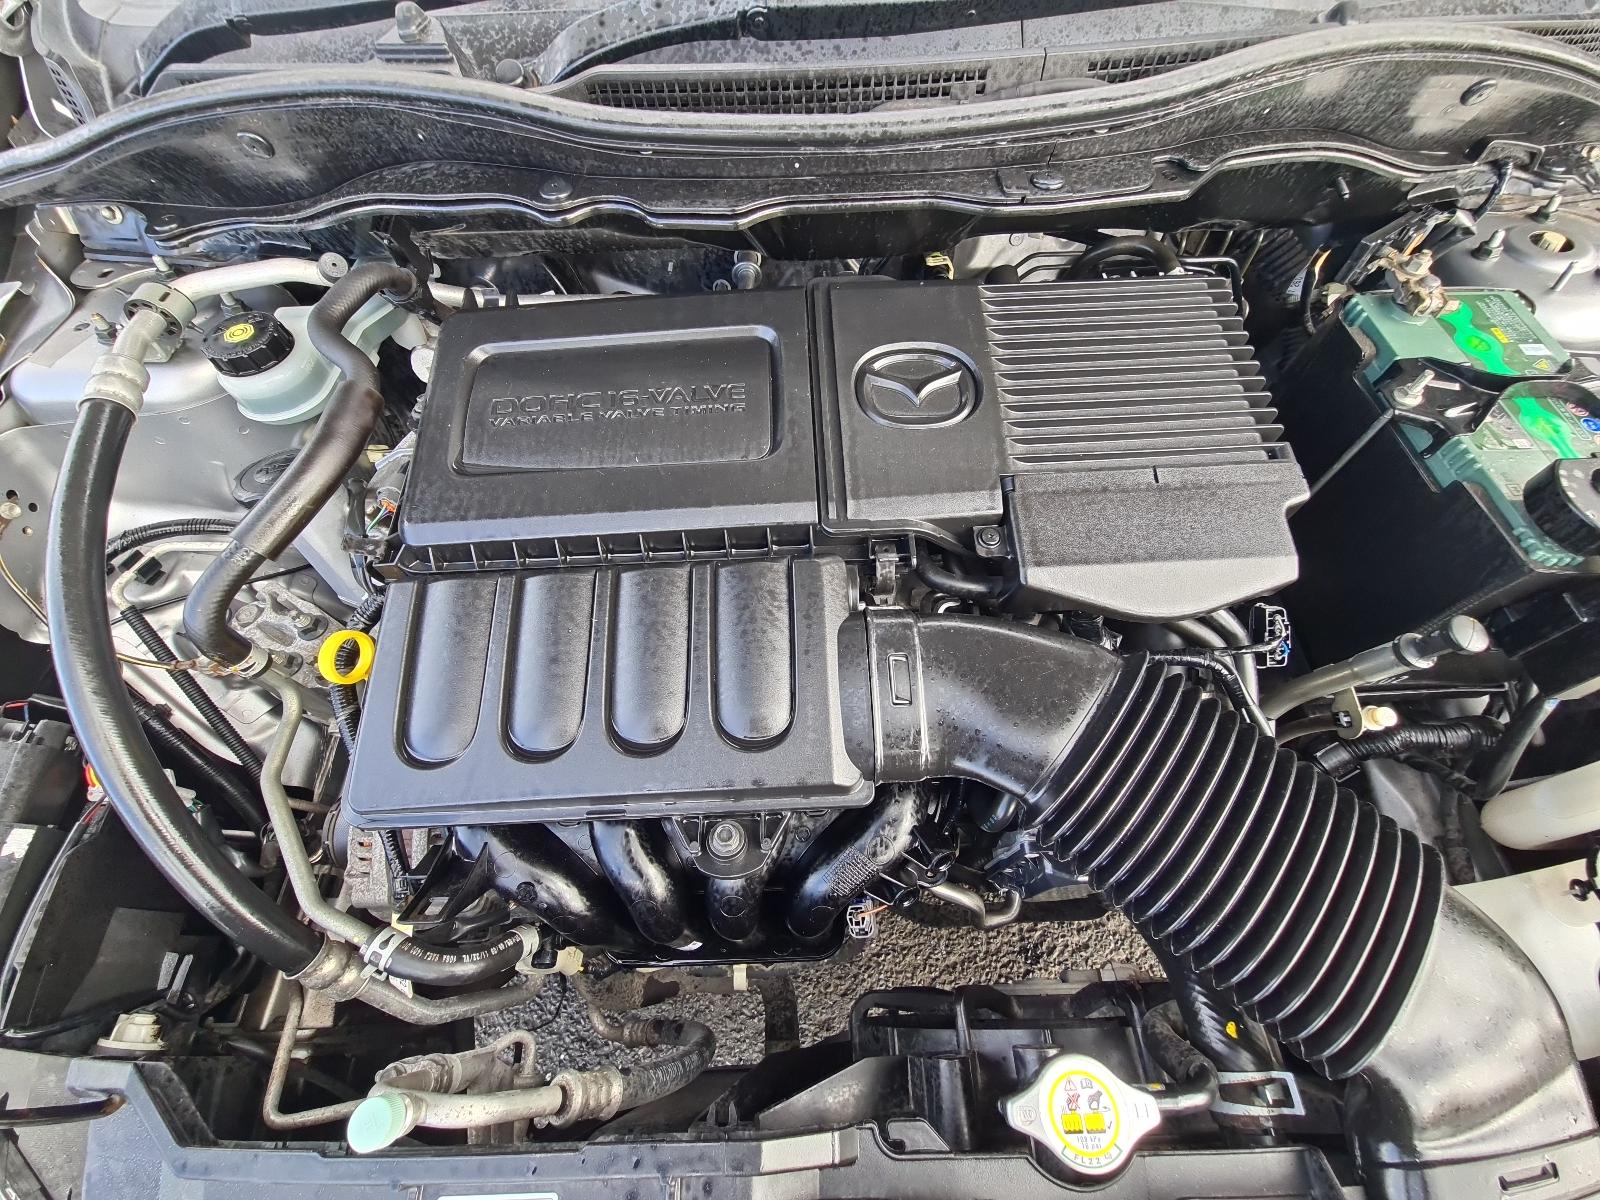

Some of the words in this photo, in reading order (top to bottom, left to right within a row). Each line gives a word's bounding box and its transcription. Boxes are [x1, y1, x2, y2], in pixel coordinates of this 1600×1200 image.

[490, 391, 602, 415] DOHC
[607, 382, 747, 406] 16-VALVE
[487, 411, 594, 428] VARIABLE
[600, 406, 665, 420] VALVE
[670, 402, 747, 415] TIMING
